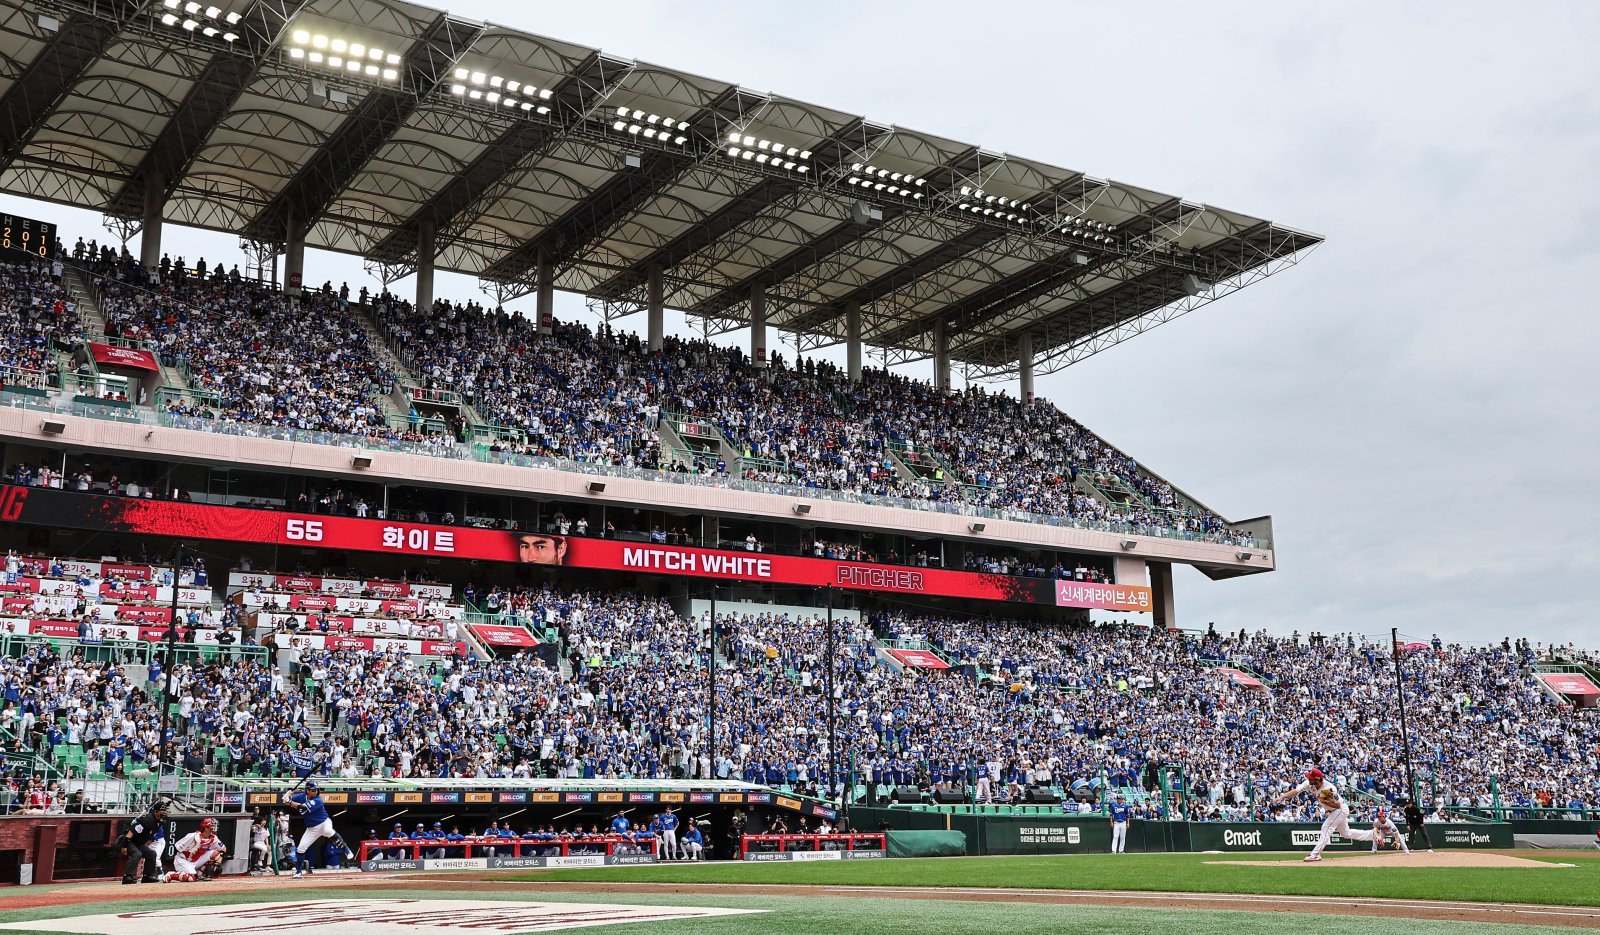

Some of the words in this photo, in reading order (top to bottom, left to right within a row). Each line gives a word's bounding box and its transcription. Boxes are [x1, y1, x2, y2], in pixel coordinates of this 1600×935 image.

[4, 215, 13, 226] H
[22, 219, 31, 230] E
[40, 223, 49, 233] B
[3, 227, 11, 238] 2
[22, 231, 30, 242] 0
[40, 235, 46, 245] 1
[3, 238, 11, 249] 0
[39, 246, 47, 256] 0
[286, 519, 323, 541] 55
[382, 526, 455, 552] 화이트
[623, 547, 696, 571] MITCH
[701, 553, 771, 577] WHITE
[837, 565, 924, 590] PITCHER
[423, 587, 441, 596] 요기요
[1060, 585, 1148, 607] 신세계라이브쇼핑
[349, 601, 369, 609] 요기요
[431, 608, 450, 617] 요기요
[324, 793, 341, 801] emart
[400, 793, 416, 801] emart
[470, 793, 487, 801] emart
[538, 793, 554, 801] emart
[603, 793, 617, 801] emart
[816, 808, 834, 817] SSG.COM
[170, 821, 177, 833] B
[169, 833, 176, 845] S
[1224, 829, 1262, 846] emart
[1294, 833, 1321, 842] TRADE
[1445, 835, 1470, 843] SHINSEGAE
[1470, 832, 1491, 845] Point
